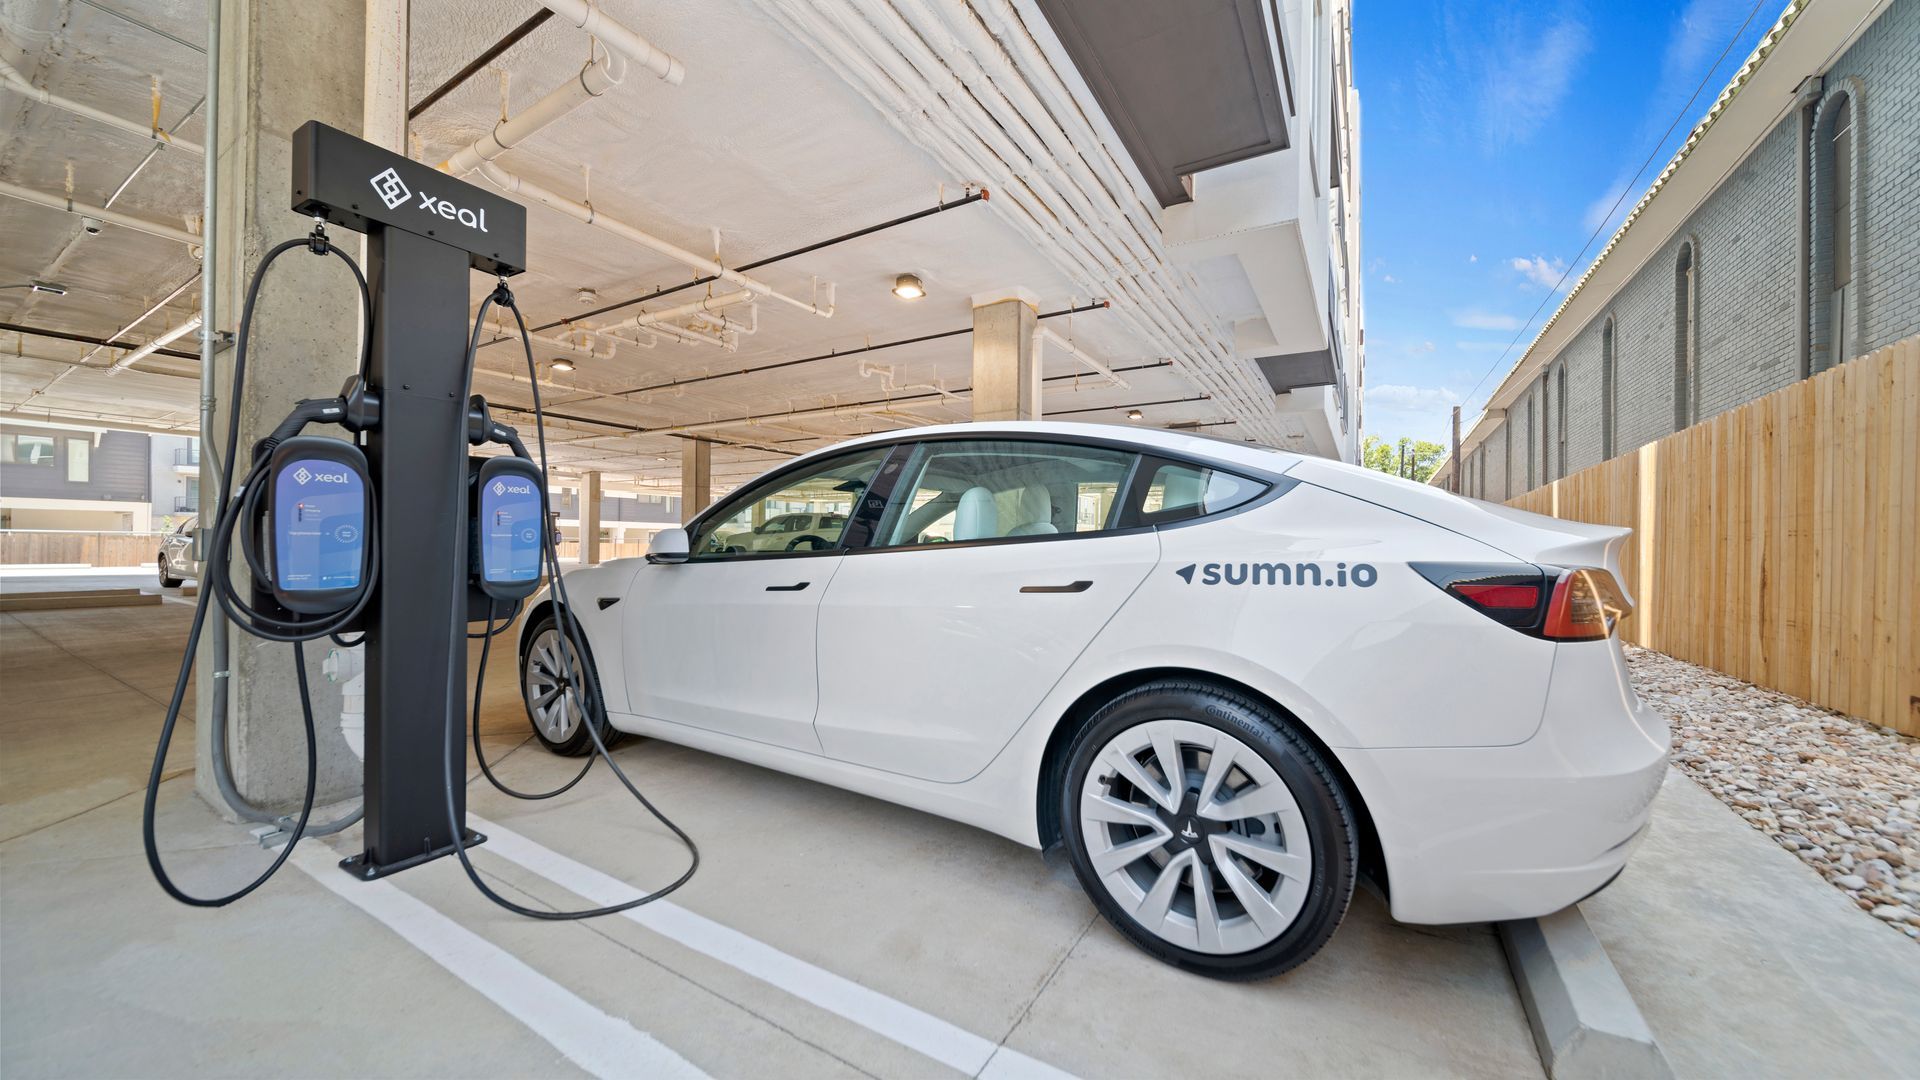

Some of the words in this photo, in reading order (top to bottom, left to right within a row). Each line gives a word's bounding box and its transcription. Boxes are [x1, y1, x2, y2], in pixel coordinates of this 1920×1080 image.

[418, 191, 489, 233] xeal
[314, 472, 349, 484] xeal
[507, 485, 531, 495] xeal
[1201, 562, 1378, 588] sumn.io
[1205, 704, 1265, 739] Continental
